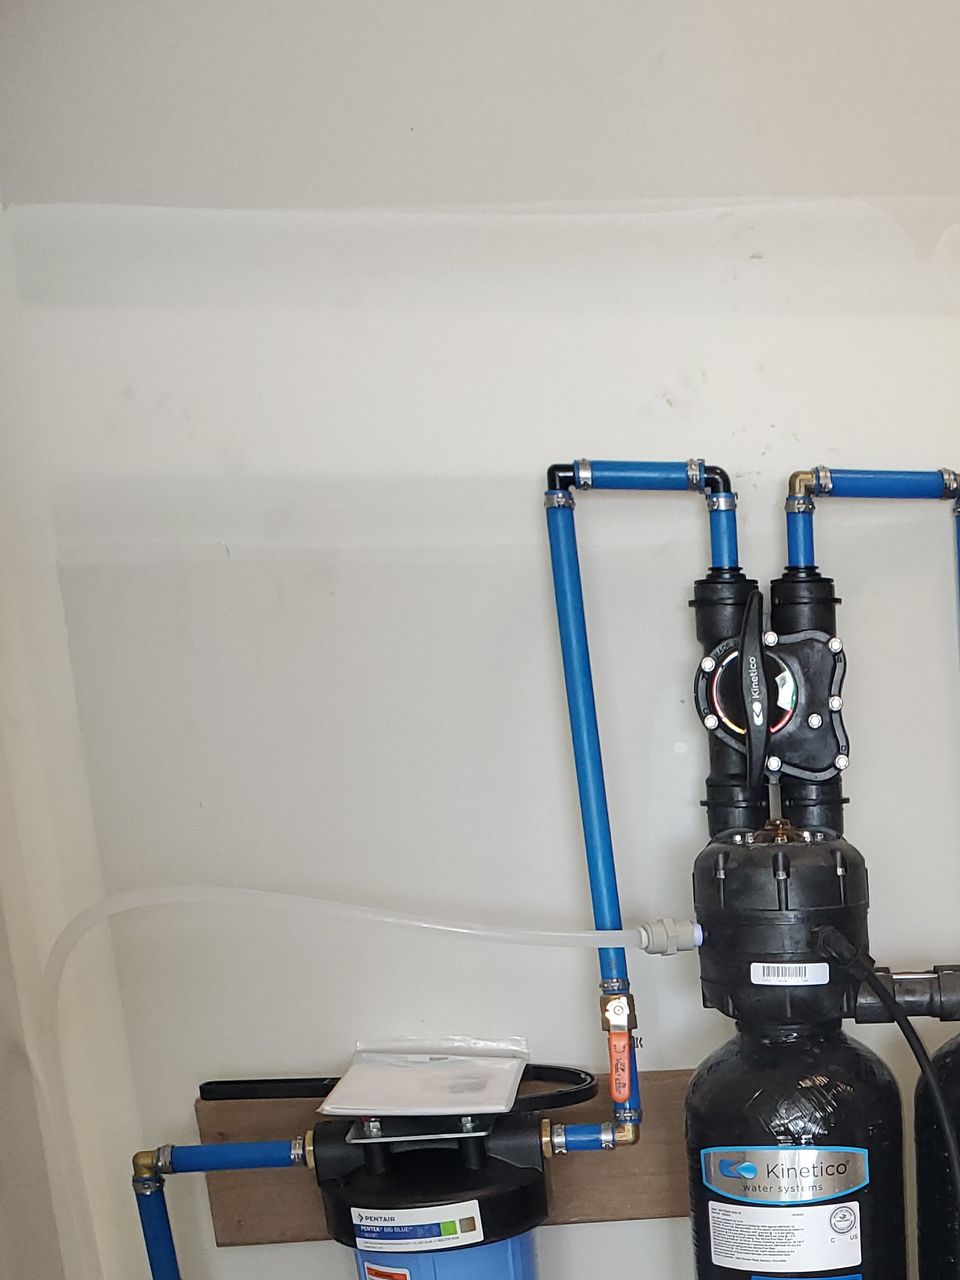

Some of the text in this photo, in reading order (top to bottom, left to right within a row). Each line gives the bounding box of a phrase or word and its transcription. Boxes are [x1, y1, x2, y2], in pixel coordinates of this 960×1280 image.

[749, 657, 760, 699] Kinetico
[766, 1161, 848, 1180] Kinetico
[743, 1184, 824, 1194] water systems
